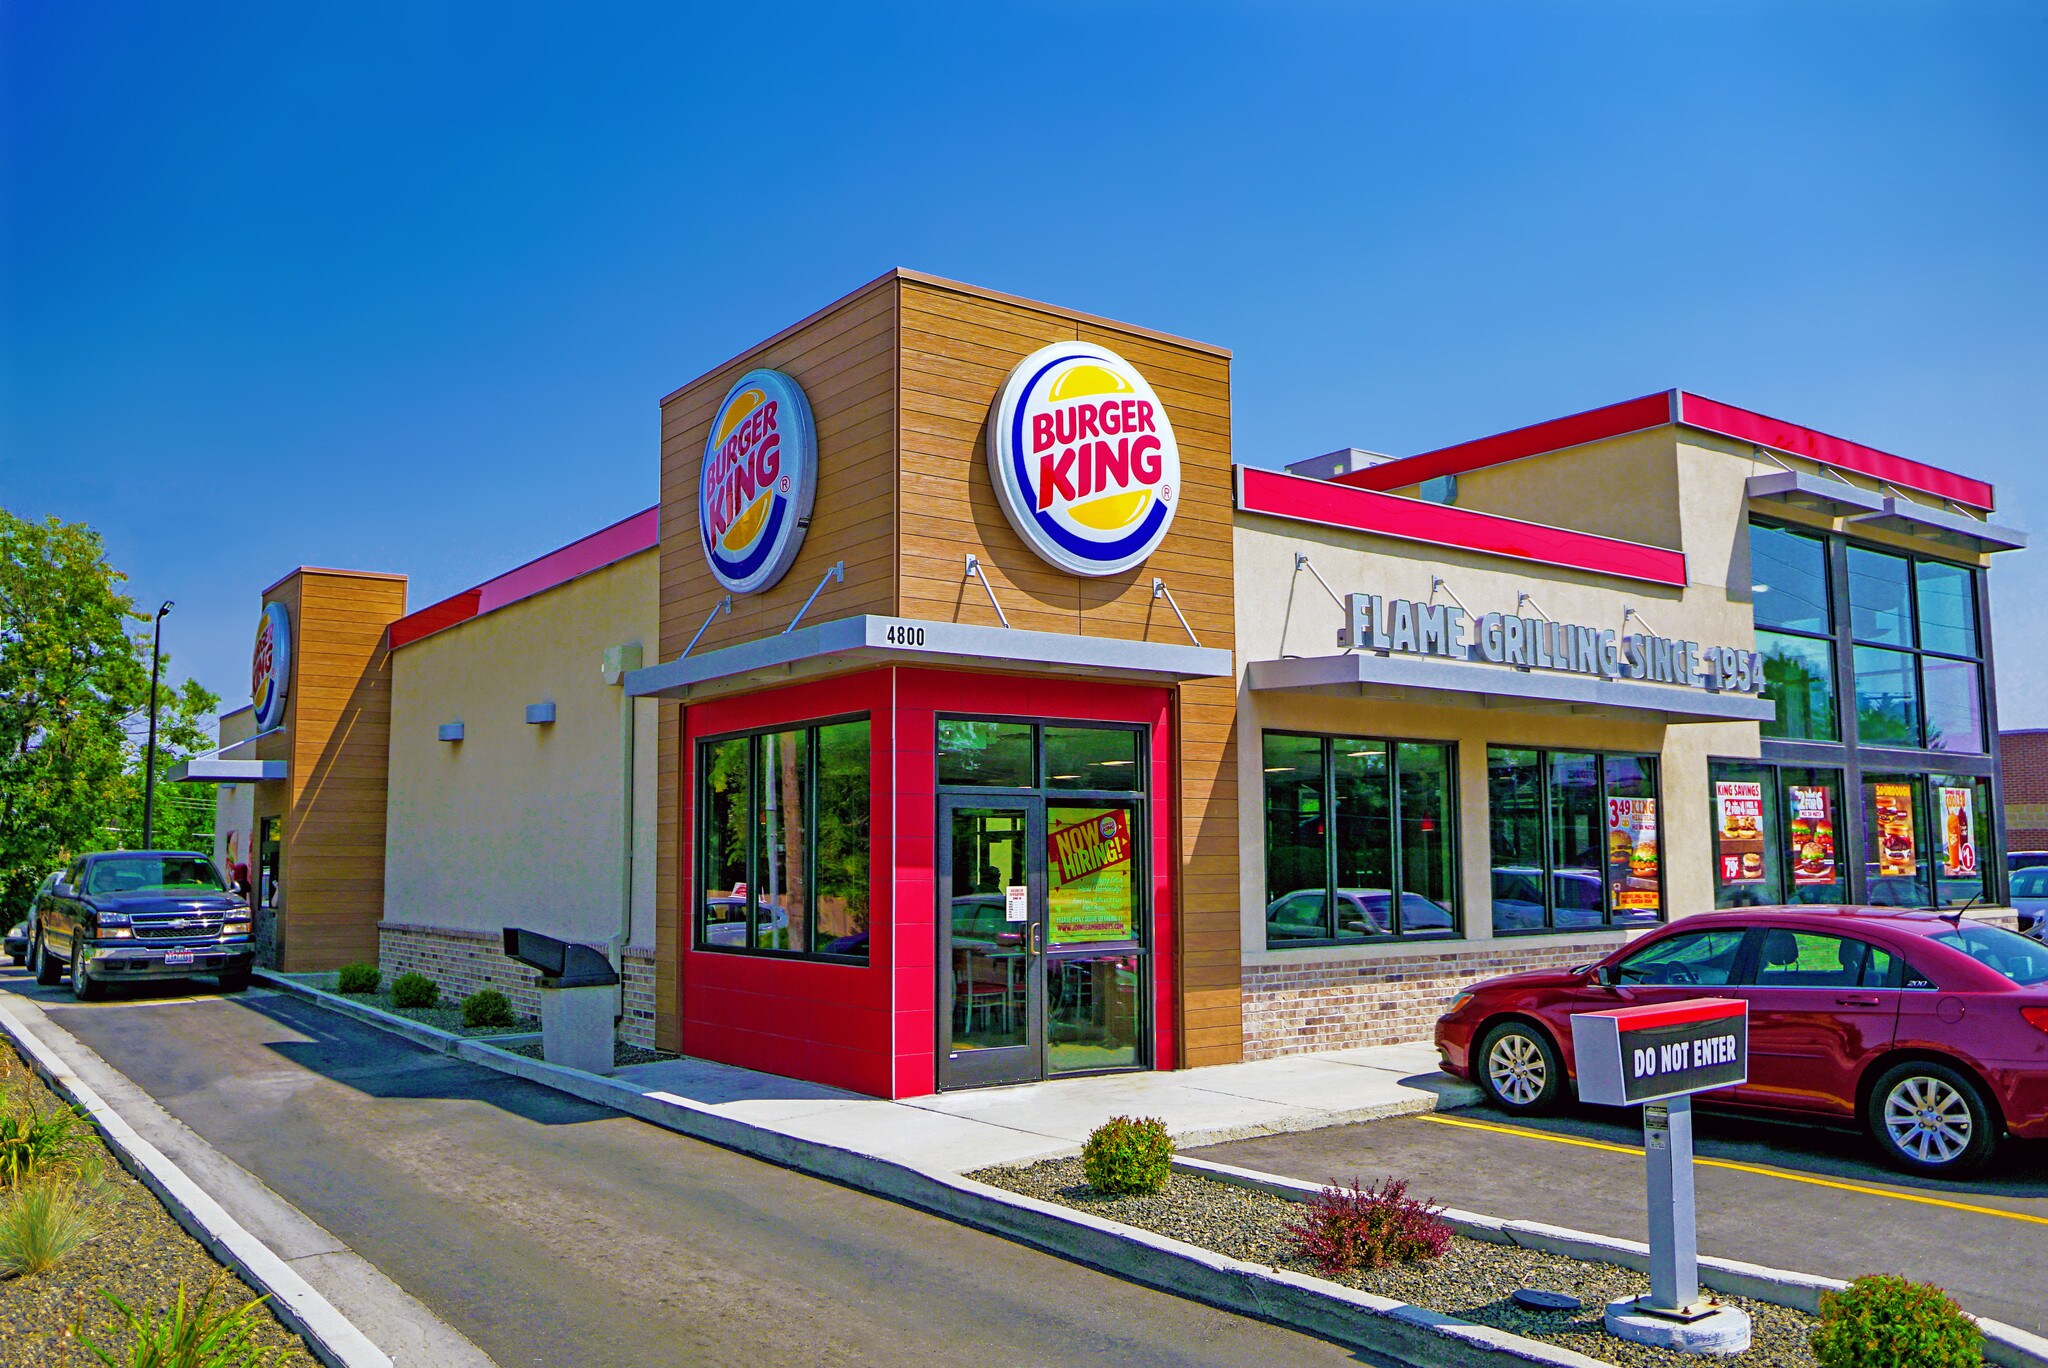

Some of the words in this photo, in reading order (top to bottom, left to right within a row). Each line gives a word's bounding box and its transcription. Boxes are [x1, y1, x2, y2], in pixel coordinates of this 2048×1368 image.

[1033, 400, 1156, 454] BURGER
[706, 400, 778, 504] BURGER
[1039, 434, 1162, 510] KING
[709, 433, 780, 553] KING
[887, 625, 925, 646] 4800
[1347, 592, 1468, 660] FLAME
[1476, 612, 1621, 678] GRILLING
[1626, 633, 1703, 687] SINCE
[1704, 646, 1766, 693] 1954
[1632, 800, 1655, 815] KING
[1717, 784, 1733, 796] KING
[1734, 785, 1759, 797] SAVINGS
[1055, 820, 1100, 858] NOW
[1061, 837, 1123, 880] HIRING!
[1634, 1047, 1656, 1078] DO
[1661, 1042, 1689, 1073] NOT
[1693, 1034, 1736, 1067] ENTER
